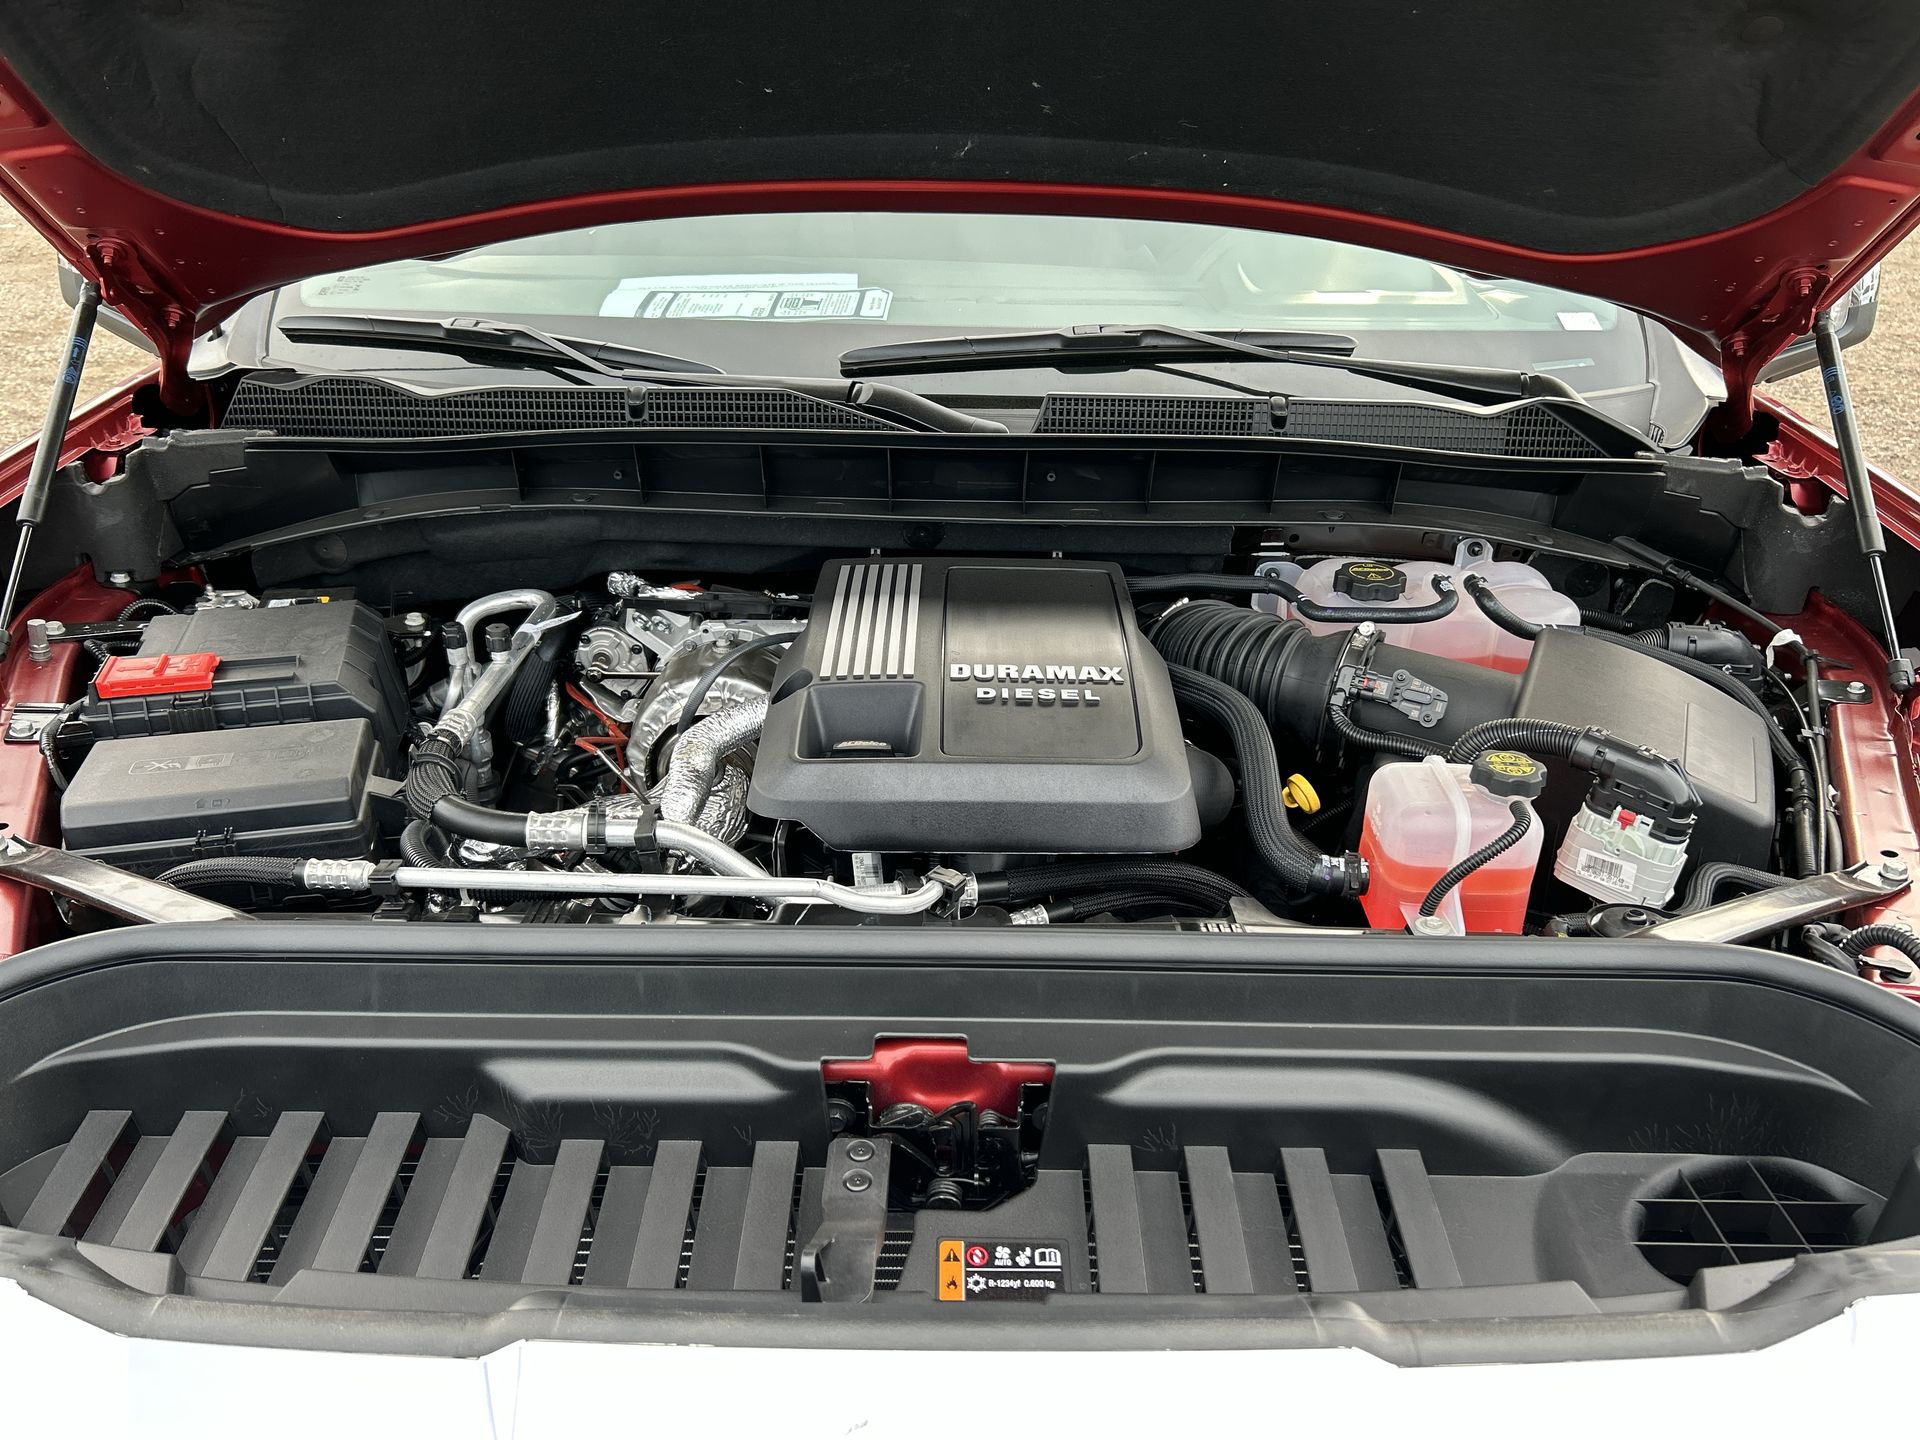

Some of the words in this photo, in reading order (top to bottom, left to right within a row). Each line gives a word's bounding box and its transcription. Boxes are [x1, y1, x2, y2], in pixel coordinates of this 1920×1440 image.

[950, 663, 1124, 683] DURAMAX
[976, 687, 1100, 702] DIESEL
[994, 1258, 1012, 1266] AUTO
[1045, 1279, 1055, 1289] kg
